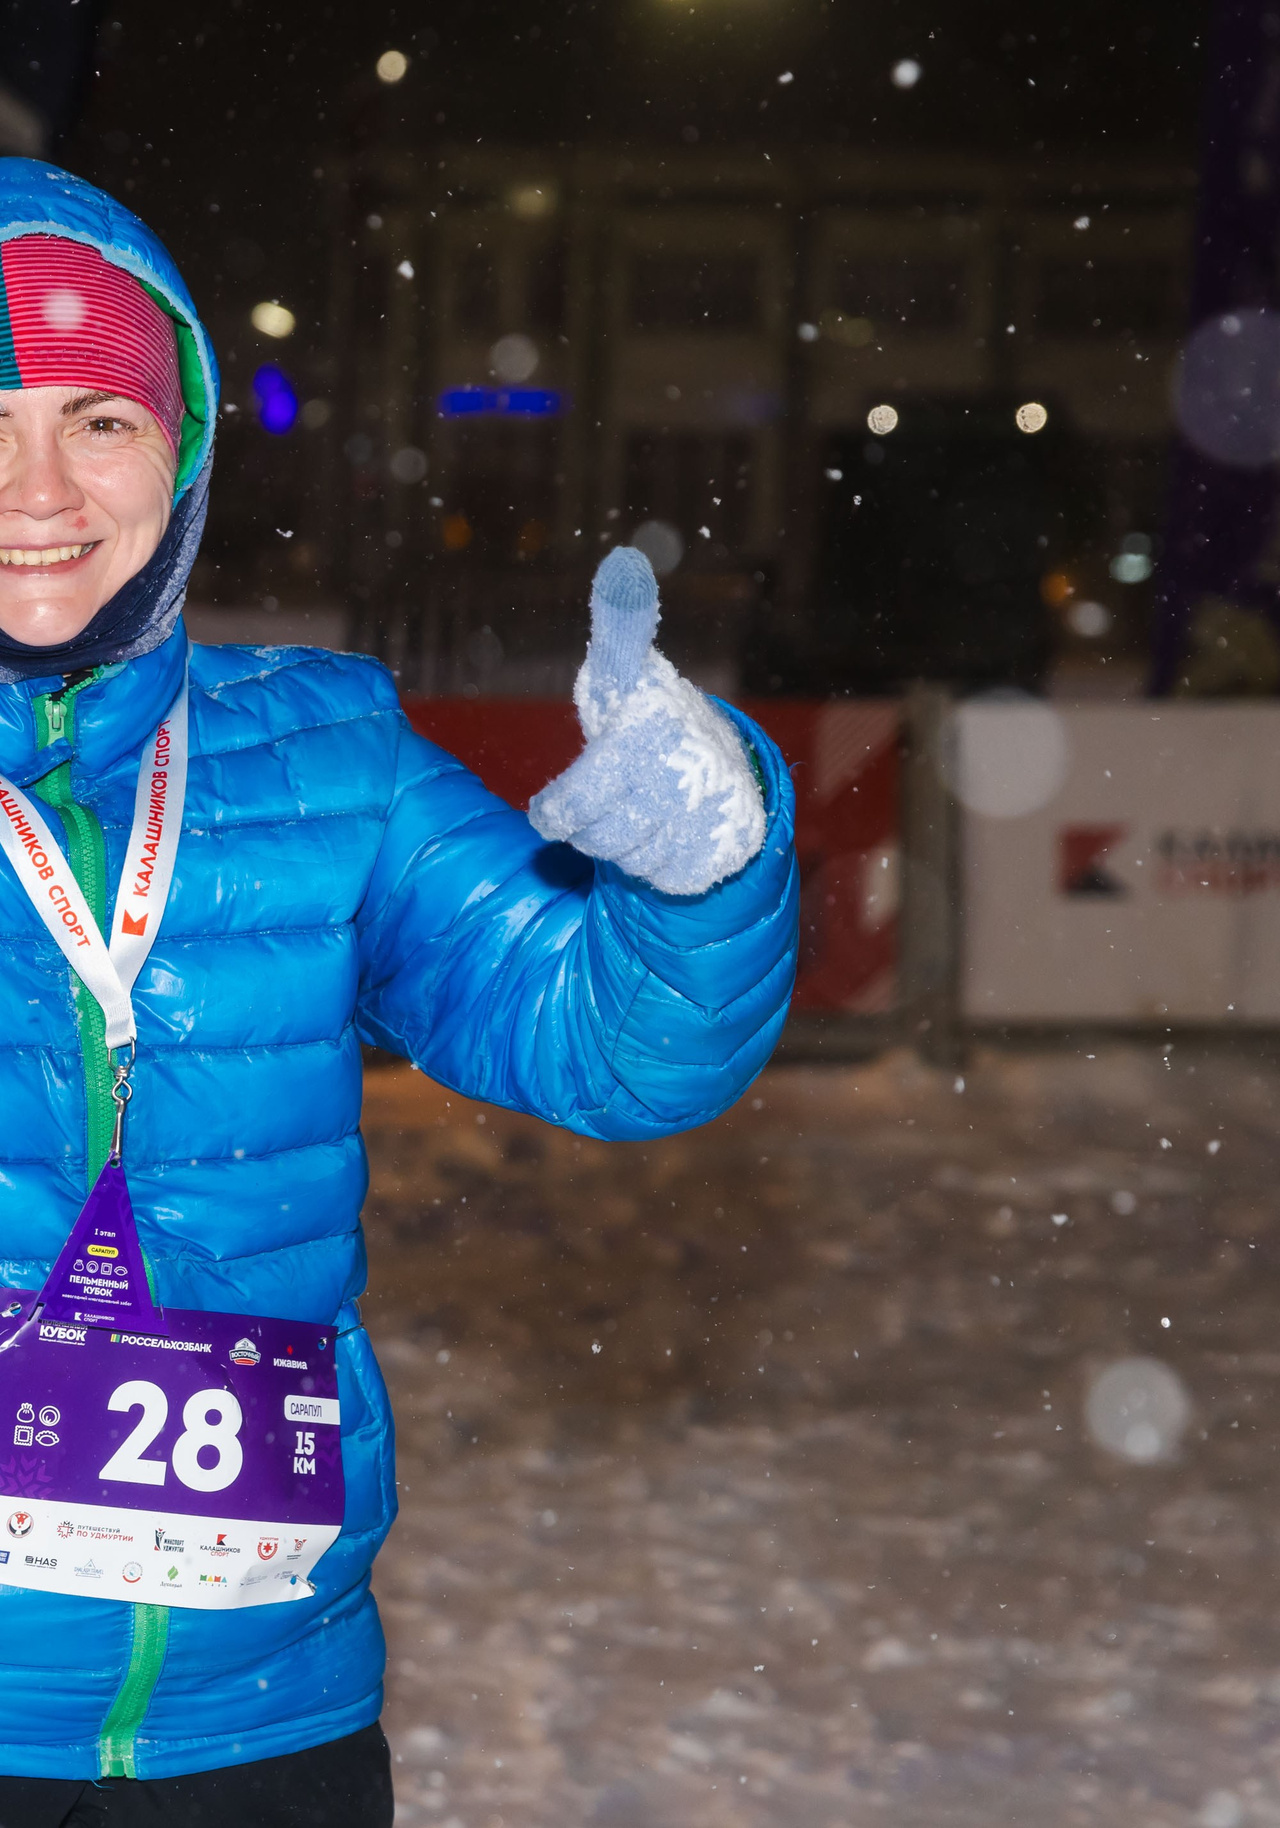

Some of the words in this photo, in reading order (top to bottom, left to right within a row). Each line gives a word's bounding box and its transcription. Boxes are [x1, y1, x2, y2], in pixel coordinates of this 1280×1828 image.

[133, 771, 168, 897] КАЛАШНИКОВ
[154, 719, 171, 768] СПОРТ
[48, 884, 91, 948] СПОРТ
[99, 1230, 116, 1238] этап
[69, 1274, 129, 1290] ПЕЛЬМЕННЫЙ
[83, 1286, 113, 1297] КУБОК
[39, 1325, 87, 1341] КУБОК
[121, 1334, 213, 1353] РОССЕЛЬХОЗБАНК
[290, 1402, 323, 1418] САРАПУЛ
[99, 1380, 243, 1492] 28
[295, 1431, 316, 1456] 15
[293, 1457, 316, 1475] КМ
[76, 1530, 89, 1538] ПО
[90, 1532, 134, 1542] УДМУРТИИ
[77, 1525, 121, 1533] ПУТЕШЕСТВУЙ
[200, 1545, 241, 1554] КАЛАШНИКОВ
[34, 1556, 58, 1567] HAS
